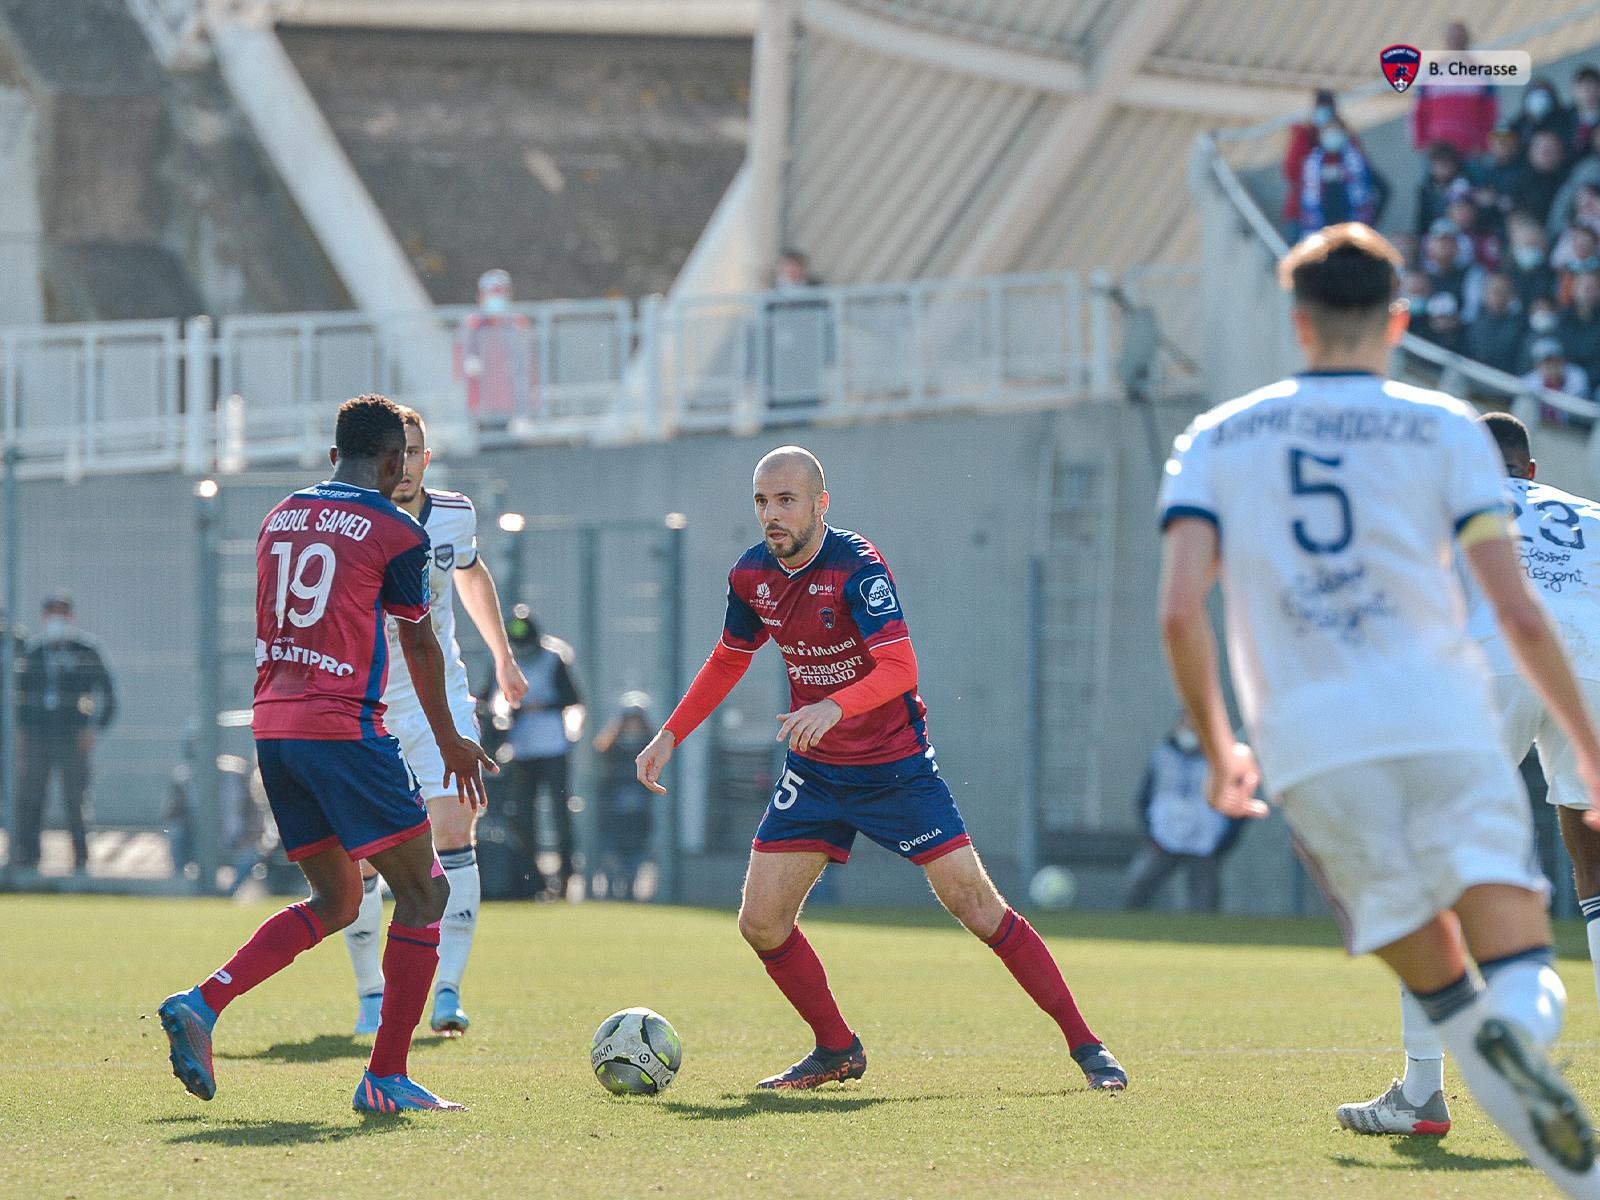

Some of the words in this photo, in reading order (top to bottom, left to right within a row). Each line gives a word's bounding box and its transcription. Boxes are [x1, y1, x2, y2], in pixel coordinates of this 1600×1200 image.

[1289, 448, 1353, 555] 5
[265, 508, 311, 533] ABDUL
[315, 508, 372, 541] SAMED
[270, 541, 337, 629] 19
[271, 645, 354, 677] BATIPRO
[811, 637, 857, 657] Mutuel
[799, 656, 863, 675] CLERMONT
[801, 669, 856, 686] FERRAND
[773, 769, 805, 811] 5
[909, 827, 943, 848] VEOLIA
